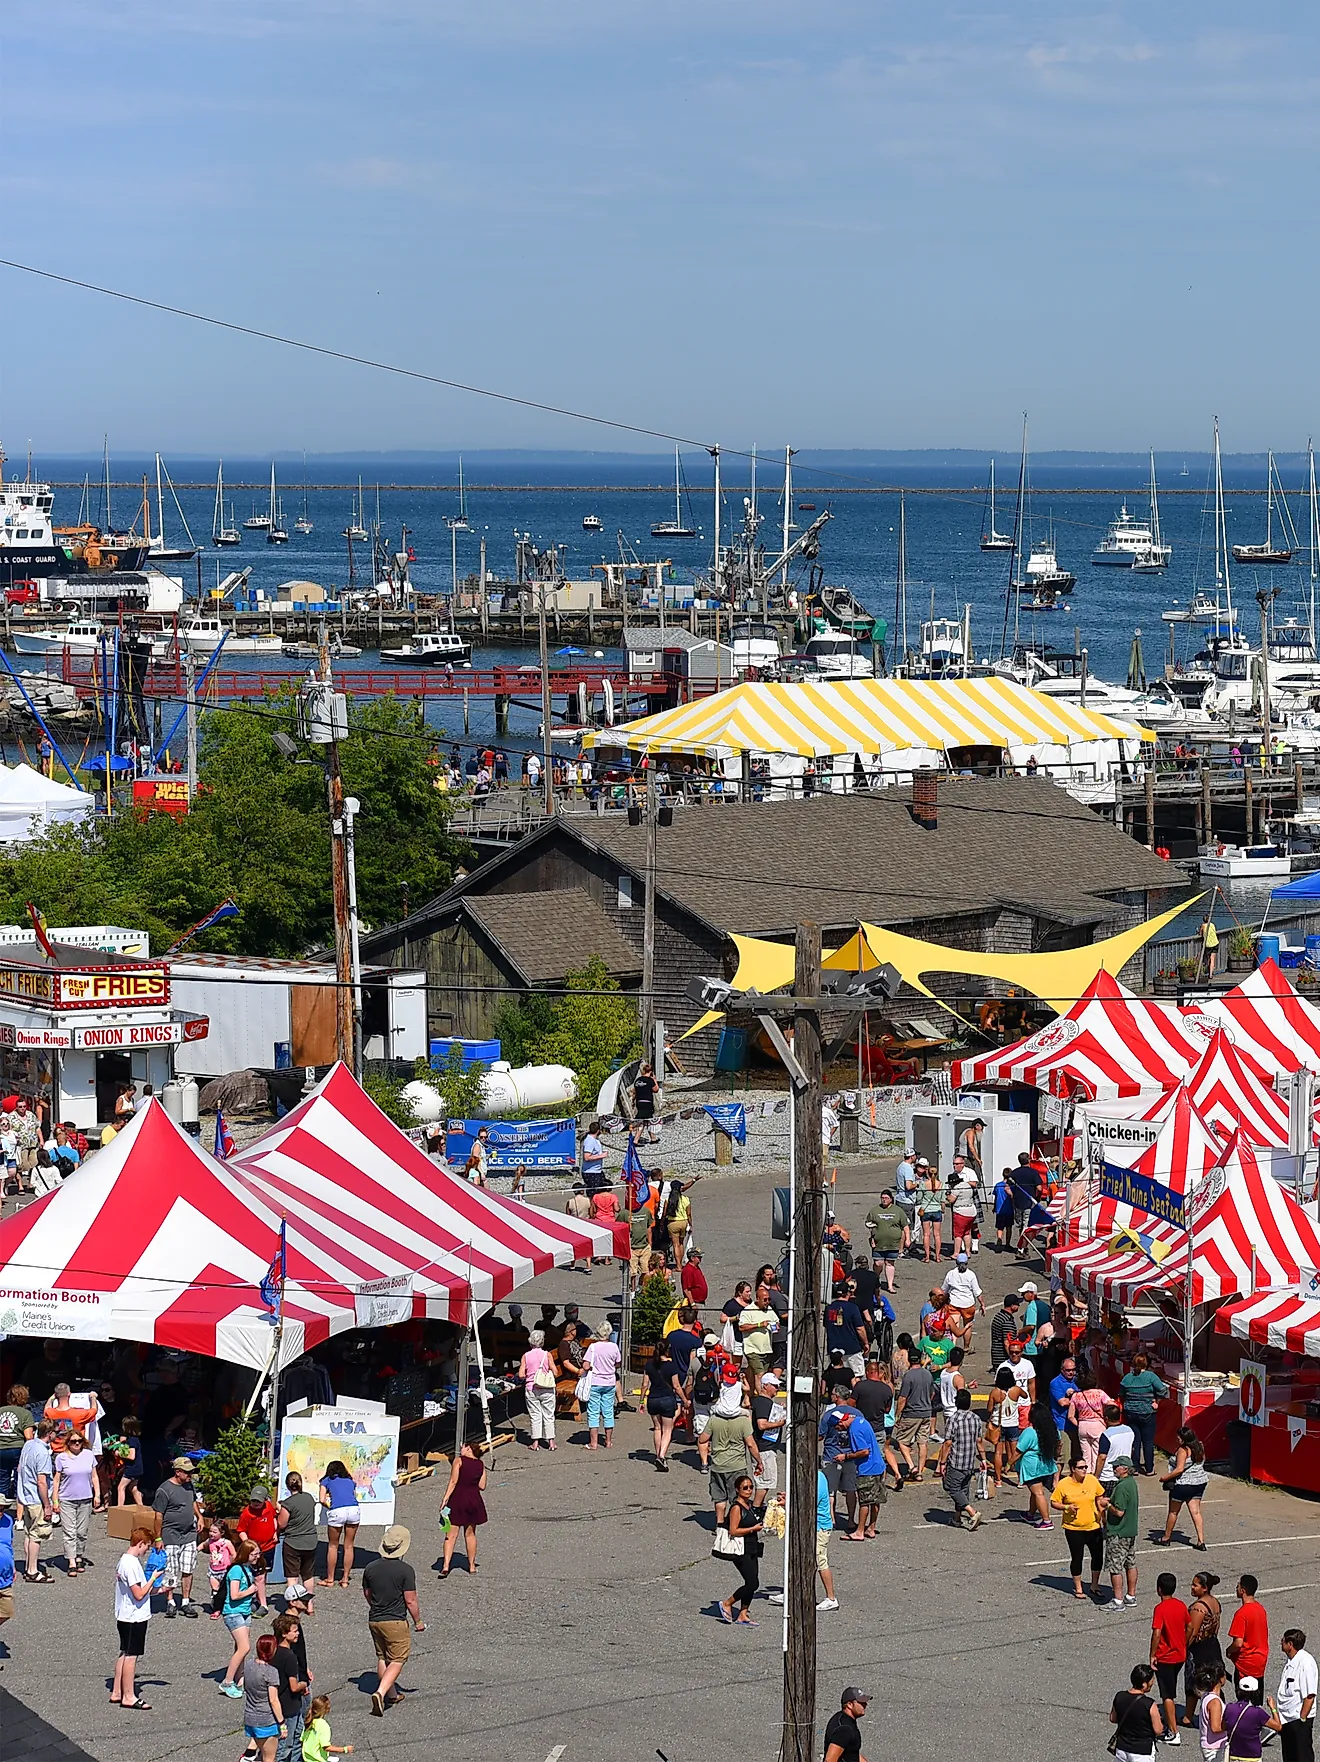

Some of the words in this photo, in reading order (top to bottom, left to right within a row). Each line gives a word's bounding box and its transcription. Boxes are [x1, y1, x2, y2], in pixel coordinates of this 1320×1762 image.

[18, 972, 49, 997] FRIES
[63, 979, 90, 988] FRESH
[94, 973, 164, 997] FRIES
[69, 987, 84, 997] CUT
[17, 1031, 41, 1044] Onion
[43, 1031, 69, 1046] Rings
[84, 1027, 123, 1046] ONION
[129, 1026, 173, 1043] RINGS
[1088, 1121, 1157, 1143] Chicken-in
[537, 1156, 563, 1164] BEER
[1101, 1165, 1123, 1198] Fried
[1125, 1175, 1148, 1208] Maine
[1150, 1185, 1185, 1226] Seafood
[360, 1280, 391, 1294] Information
[391, 1276, 408, 1289] Booth
[61, 1291, 100, 1304] Booth
[22, 1311, 52, 1320] Maine's
[21, 1319, 47, 1330] Credit
[48, 1321, 76, 1331] Unions
[329, 1420, 367, 1435] USA
